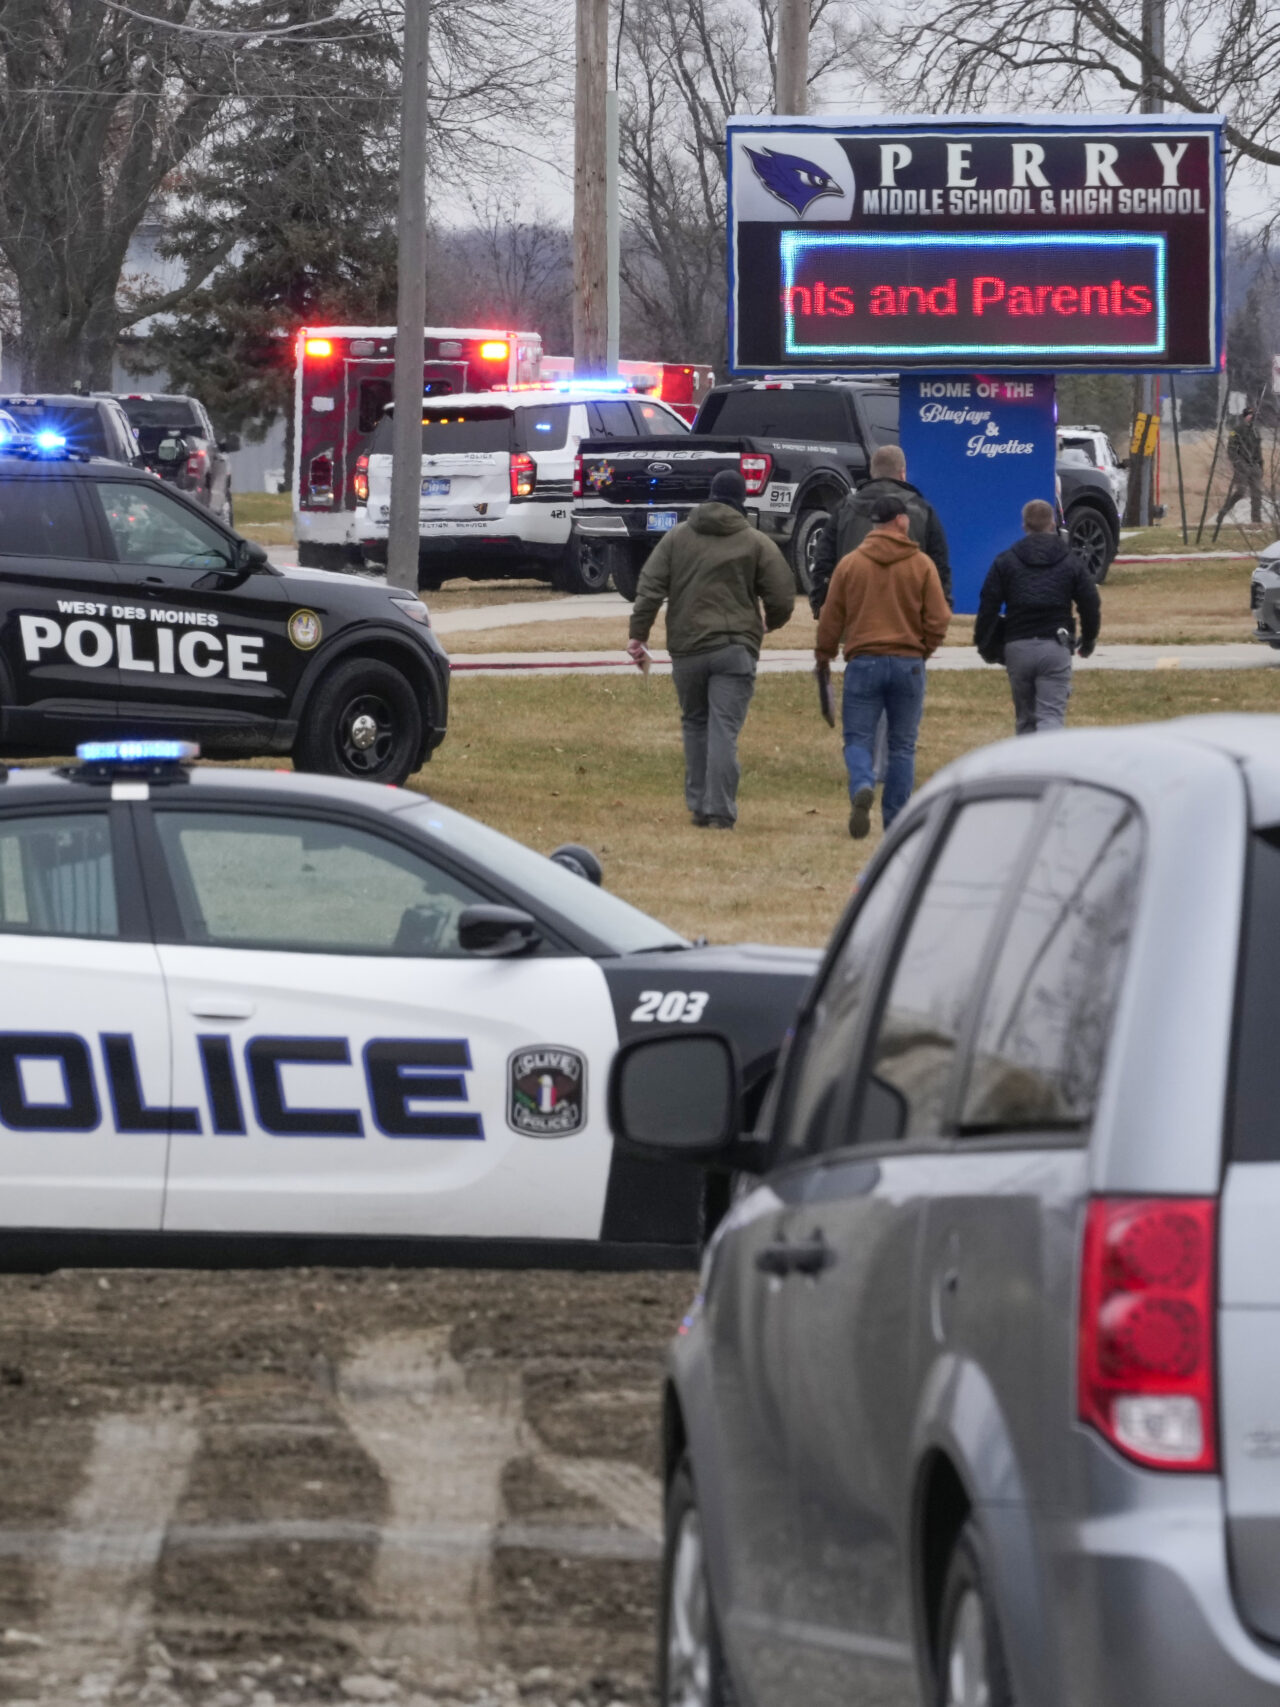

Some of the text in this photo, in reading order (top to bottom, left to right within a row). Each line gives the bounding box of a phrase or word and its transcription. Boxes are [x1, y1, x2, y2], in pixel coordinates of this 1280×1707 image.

[879, 143, 1190, 188] PERRY
[862, 188, 1206, 216] MIDDLE SCHOOL & HIGH SCHOOL
[869, 278, 957, 317] and
[972, 276, 1152, 316] Parents
[920, 382, 1034, 398] HOME OF THE
[919, 402, 991, 425] Bluejays
[985, 421, 1000, 437] &
[617, 451, 704, 459] POLICE
[966, 435, 1035, 458] Jayettes
[770, 490, 792, 502] 911
[551, 509, 567, 519] 421
[57, 600, 219, 627] WEST DES MOINES
[19, 615, 268, 682] POLICE
[630, 990, 710, 1023] 203
[523, 1053, 572, 1069] CLIVE
[522, 1117, 570, 1131] POLICE
